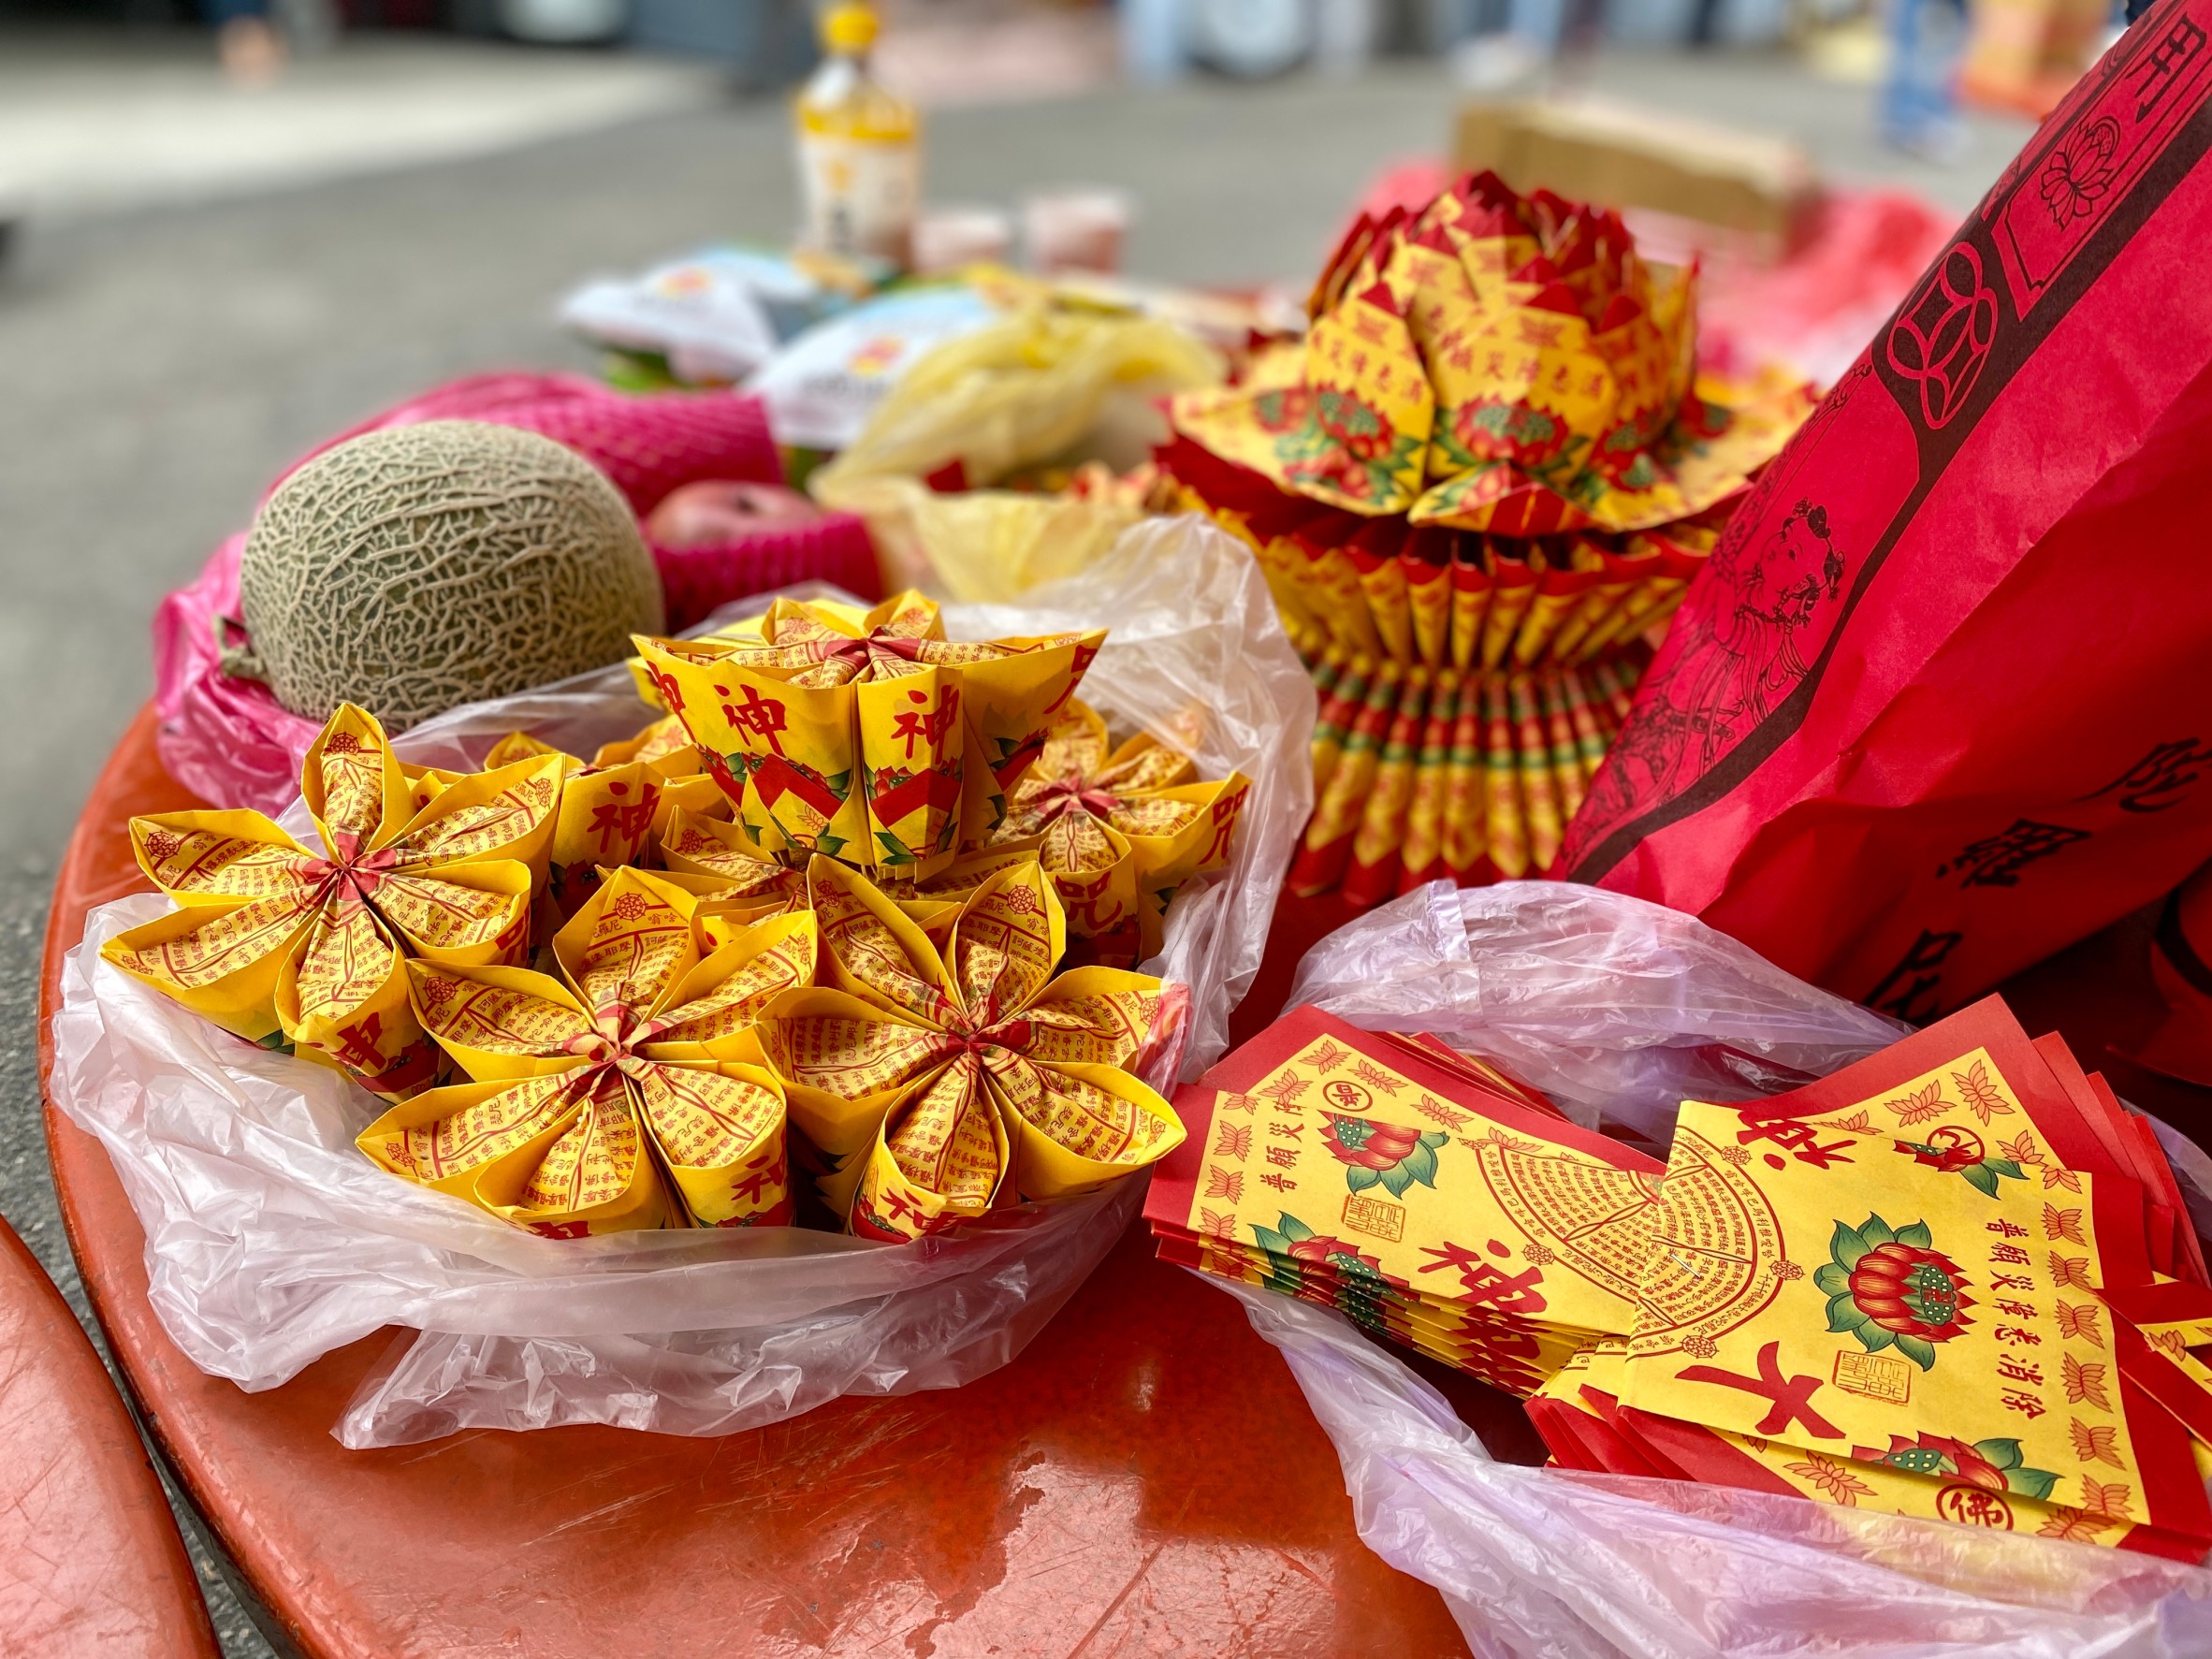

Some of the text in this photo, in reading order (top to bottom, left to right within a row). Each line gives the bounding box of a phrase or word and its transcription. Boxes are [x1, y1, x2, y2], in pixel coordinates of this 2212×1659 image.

[2126, 12, 2207, 124] 用
[714, 684, 788, 758] 神
[891, 685, 960, 765] 神
[587, 781, 661, 865] 神
[1985, 1218, 2047, 1420] 普願災障悉消除
[1674, 1341, 1847, 1439] 大
